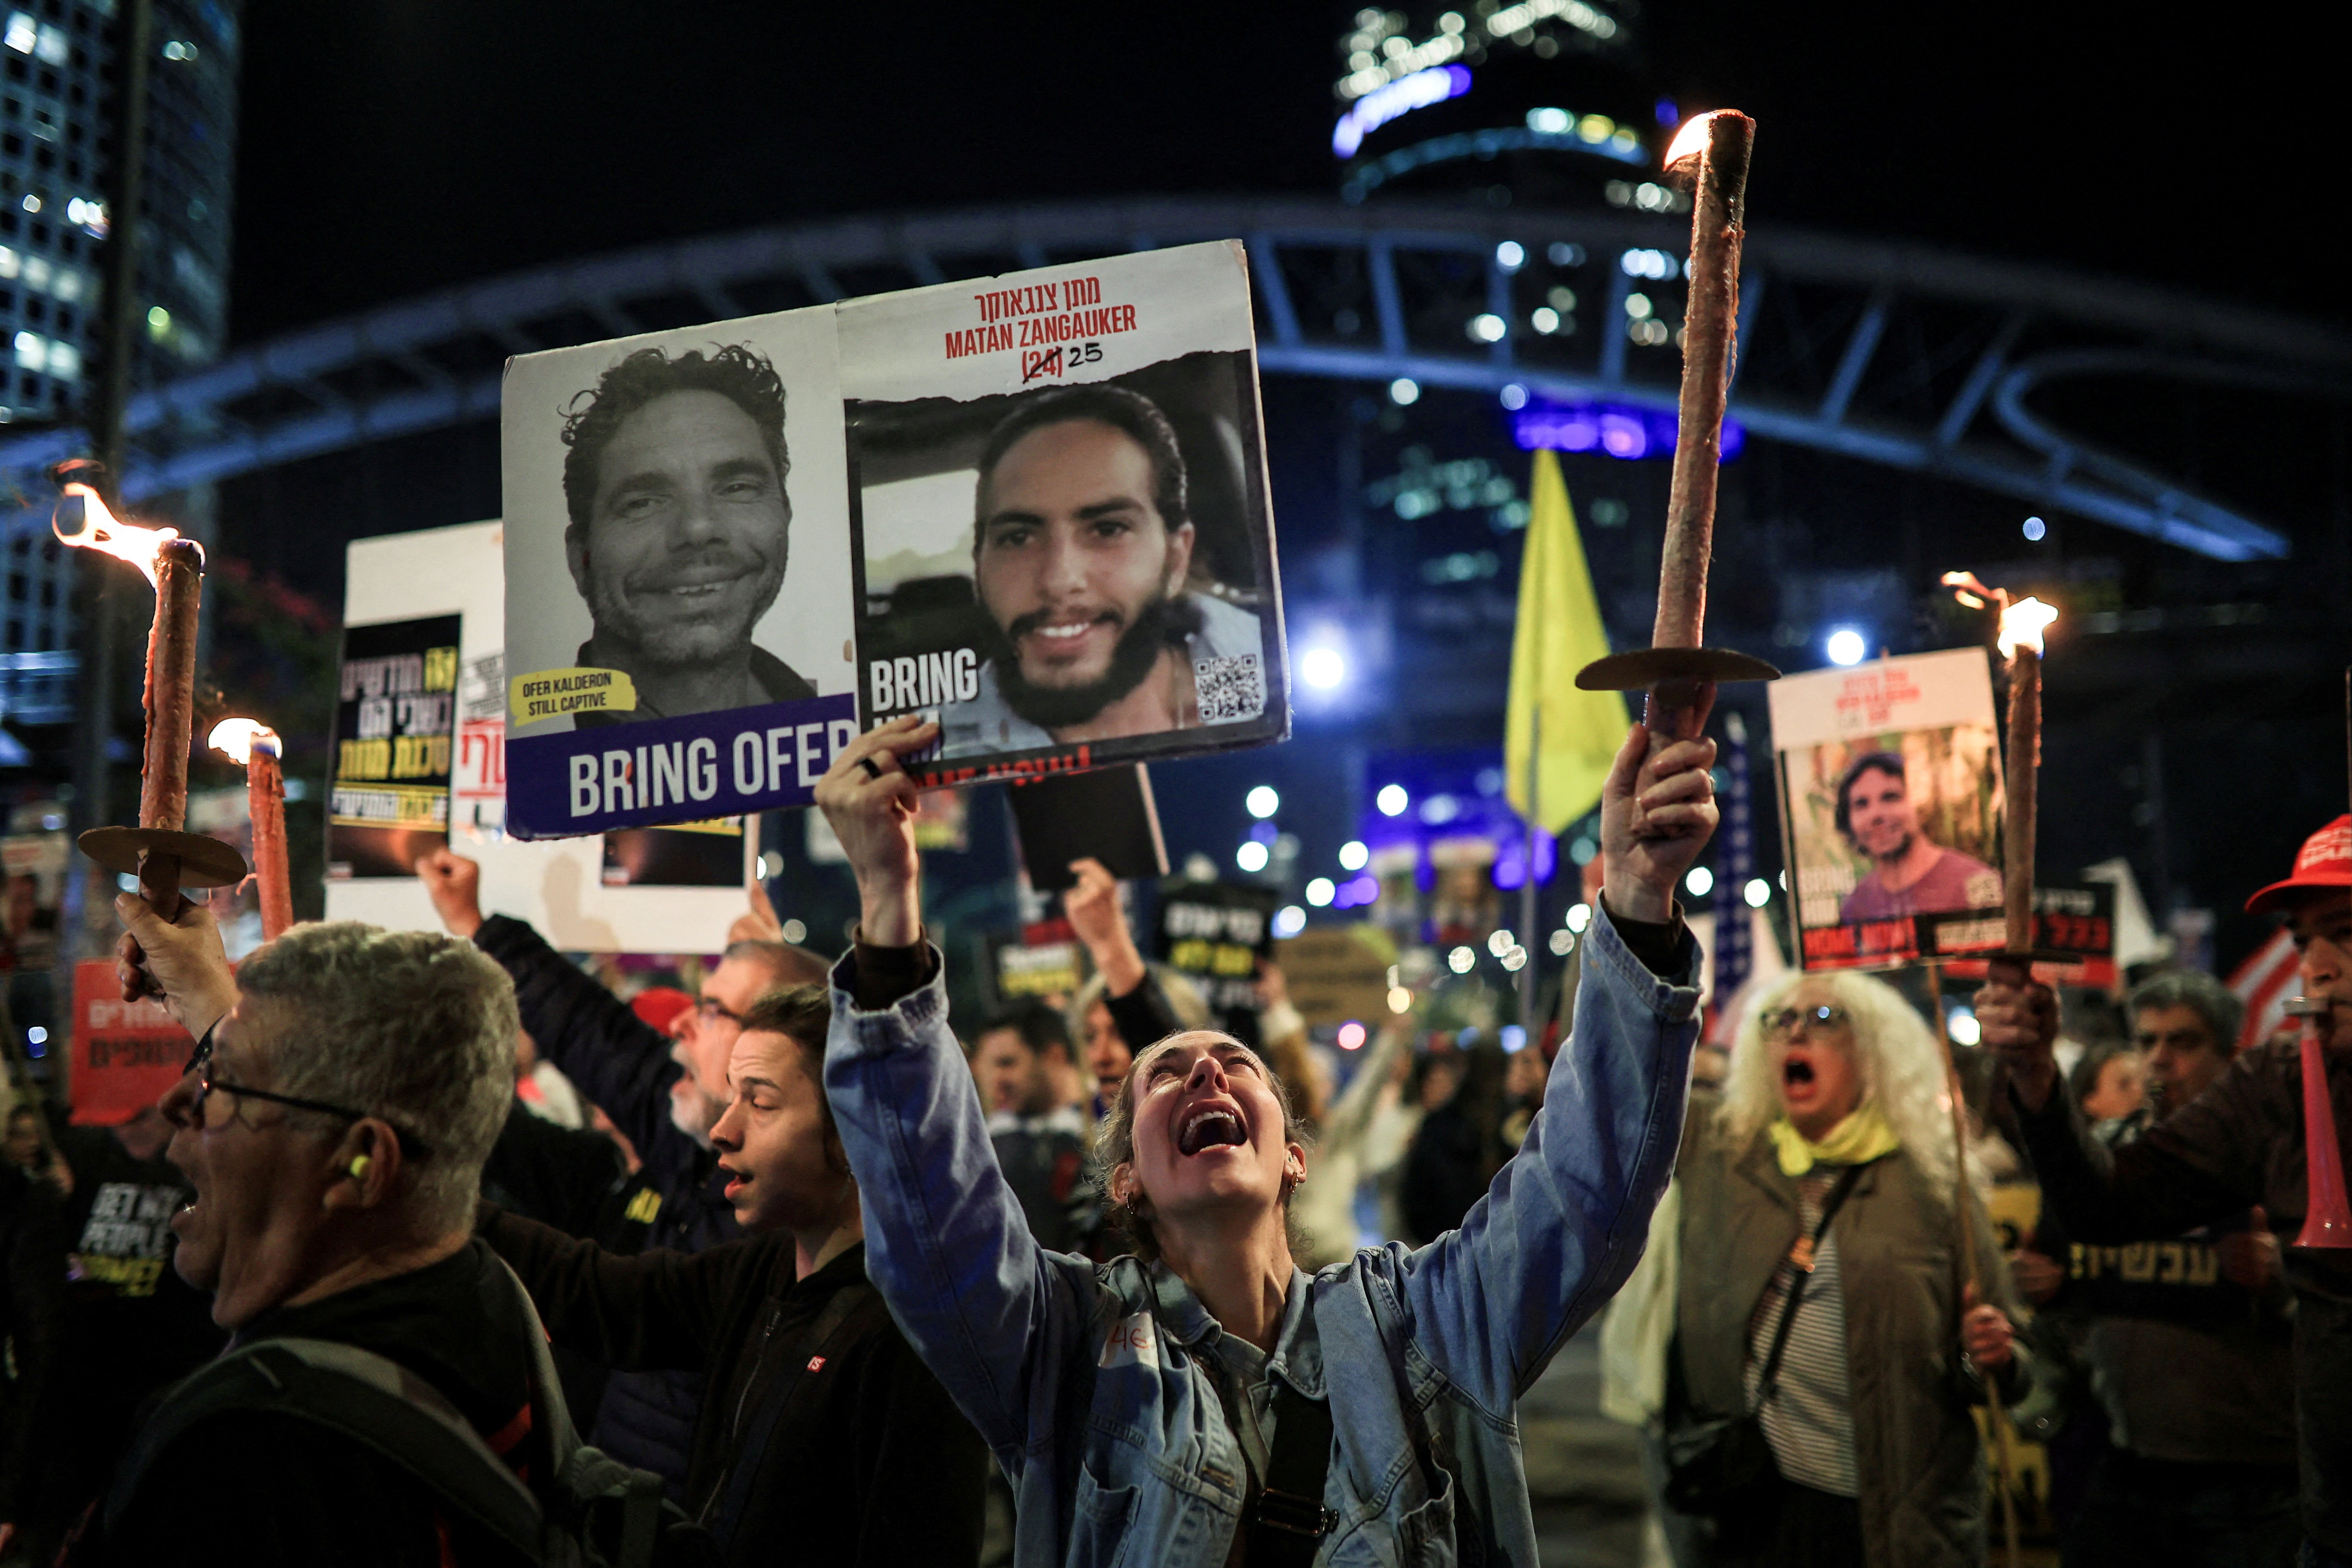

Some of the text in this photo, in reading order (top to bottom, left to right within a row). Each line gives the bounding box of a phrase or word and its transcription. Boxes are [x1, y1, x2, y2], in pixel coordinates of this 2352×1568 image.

[974, 276, 1101, 323] מתן צנגאוקר
[946, 304, 1137, 359] MATAN ZANGAUKER
[1022, 346, 1063, 383] (24)
[1069, 343, 1103, 368] 25
[523, 672, 612, 697] OFER KALDERON
[870, 647, 978, 712] BRING
[529, 692, 606, 716] STILL CAPTIVE
[570, 737, 718, 817] BRING
[1110, 1324, 1149, 1352] 46
